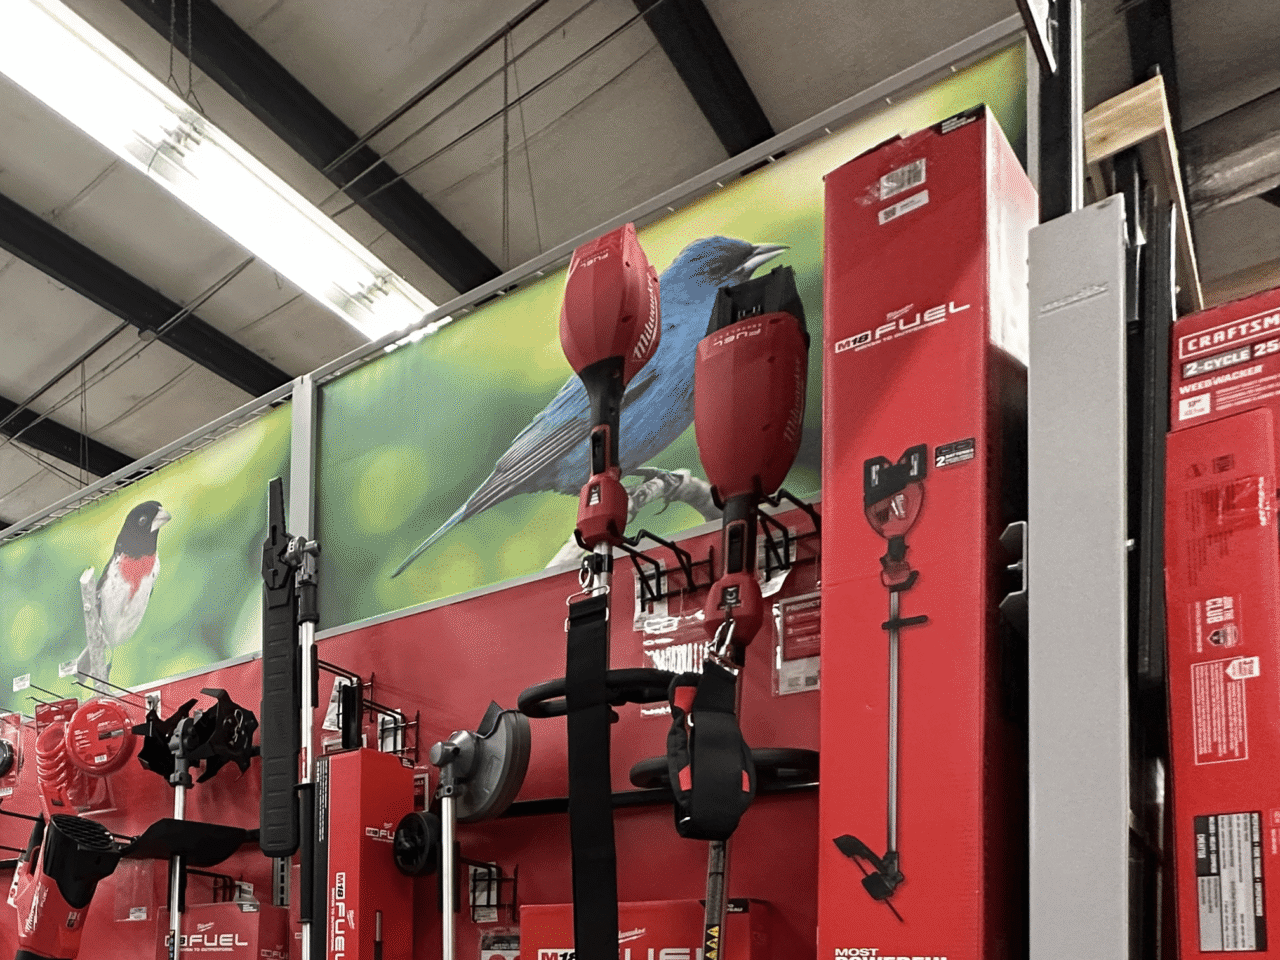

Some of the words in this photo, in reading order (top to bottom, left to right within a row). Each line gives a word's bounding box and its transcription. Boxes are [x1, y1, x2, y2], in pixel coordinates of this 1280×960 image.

[836, 333, 870, 351] M18
[875, 302, 970, 339] FUEL
[1187, 313, 1280, 352] CRAFTSM
[1186, 349, 1251, 376] 2-CYCLE
[336, 873, 345, 899] M18
[189, 934, 248, 946] FUEL
[834, 948, 878, 956] MOST
